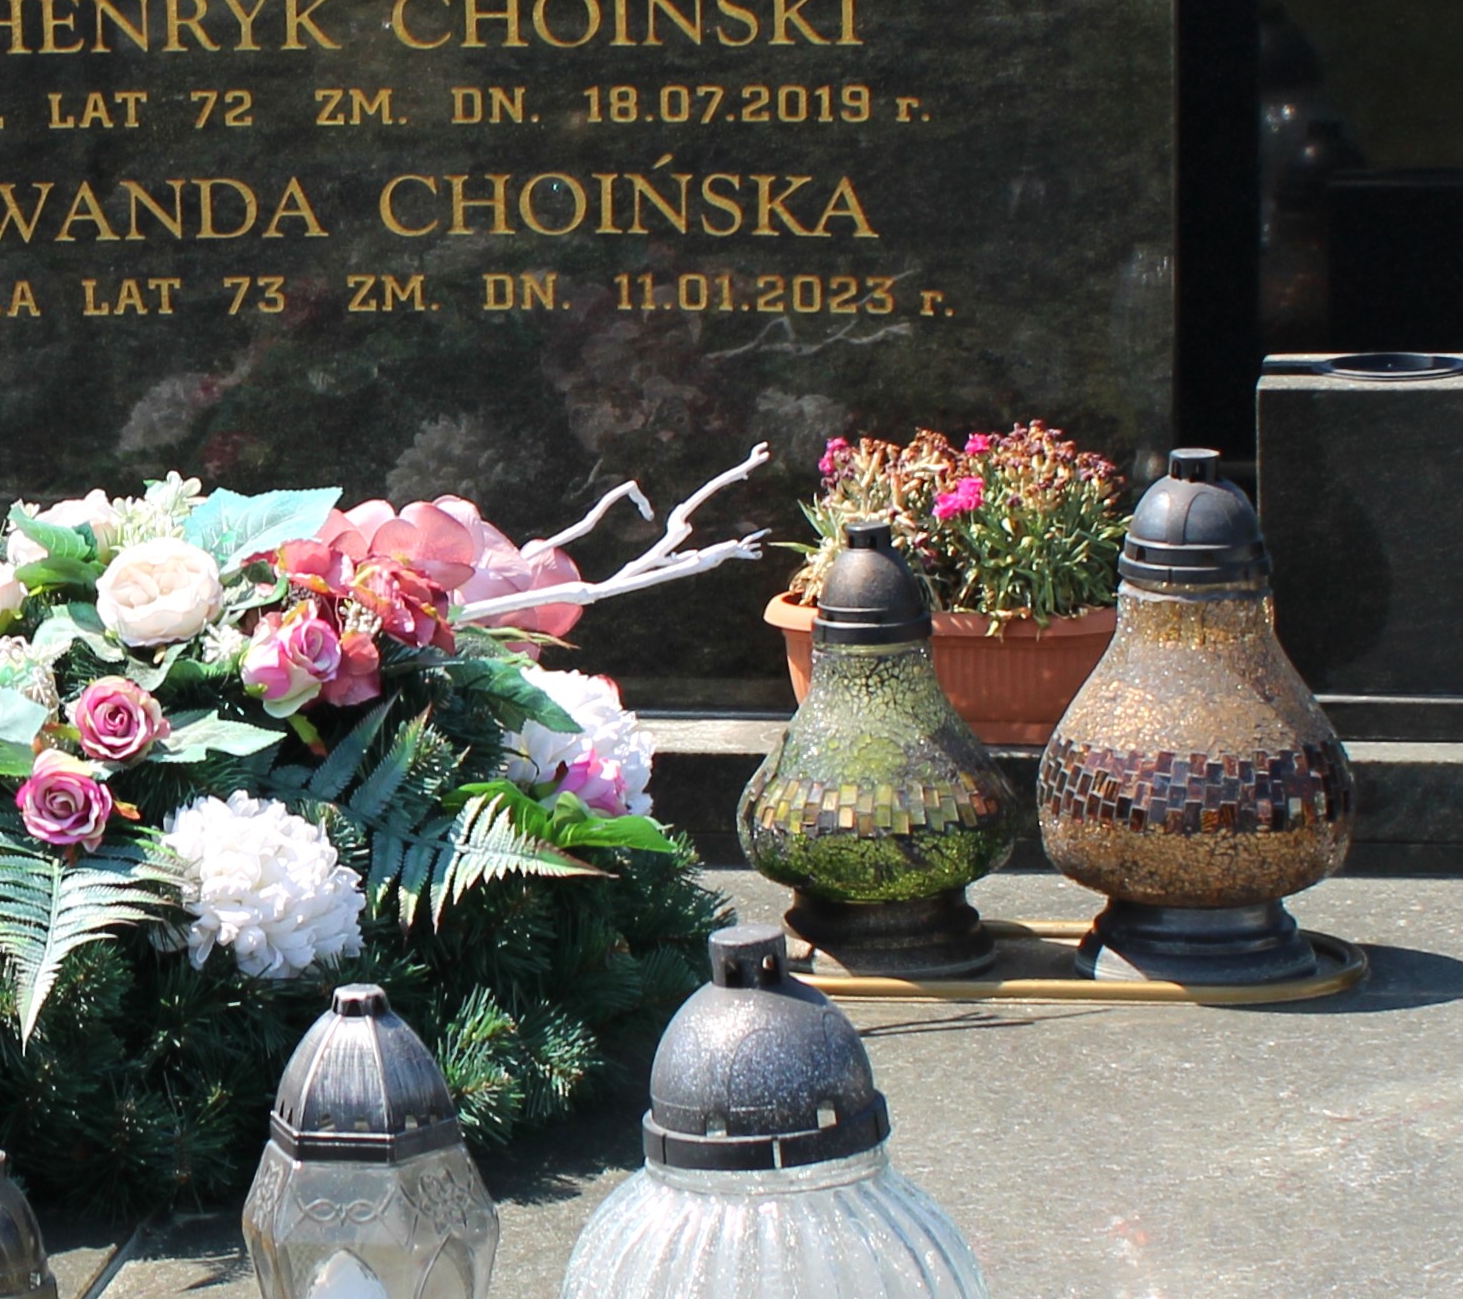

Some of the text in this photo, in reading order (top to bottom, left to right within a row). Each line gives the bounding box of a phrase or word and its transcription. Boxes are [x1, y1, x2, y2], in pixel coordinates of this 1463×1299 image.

[47, 90, 148, 129] LAT
[189, 88, 254, 129] 72
[314, 87, 408, 126] ZM.
[450, 85, 540, 125] DN.
[583, 84, 871, 124] 18.07.2019
[895, 96, 931, 123] r.
[378, 152, 880, 238] CHOIŃSKA
[81, 276, 181, 316] LAT
[222, 275, 286, 315] 73
[345, 273, 440, 313] ZM.
[482, 271, 571, 312] DN.
[613, 271, 896, 314] 11.01.2023
[919, 289, 955, 318] r.
